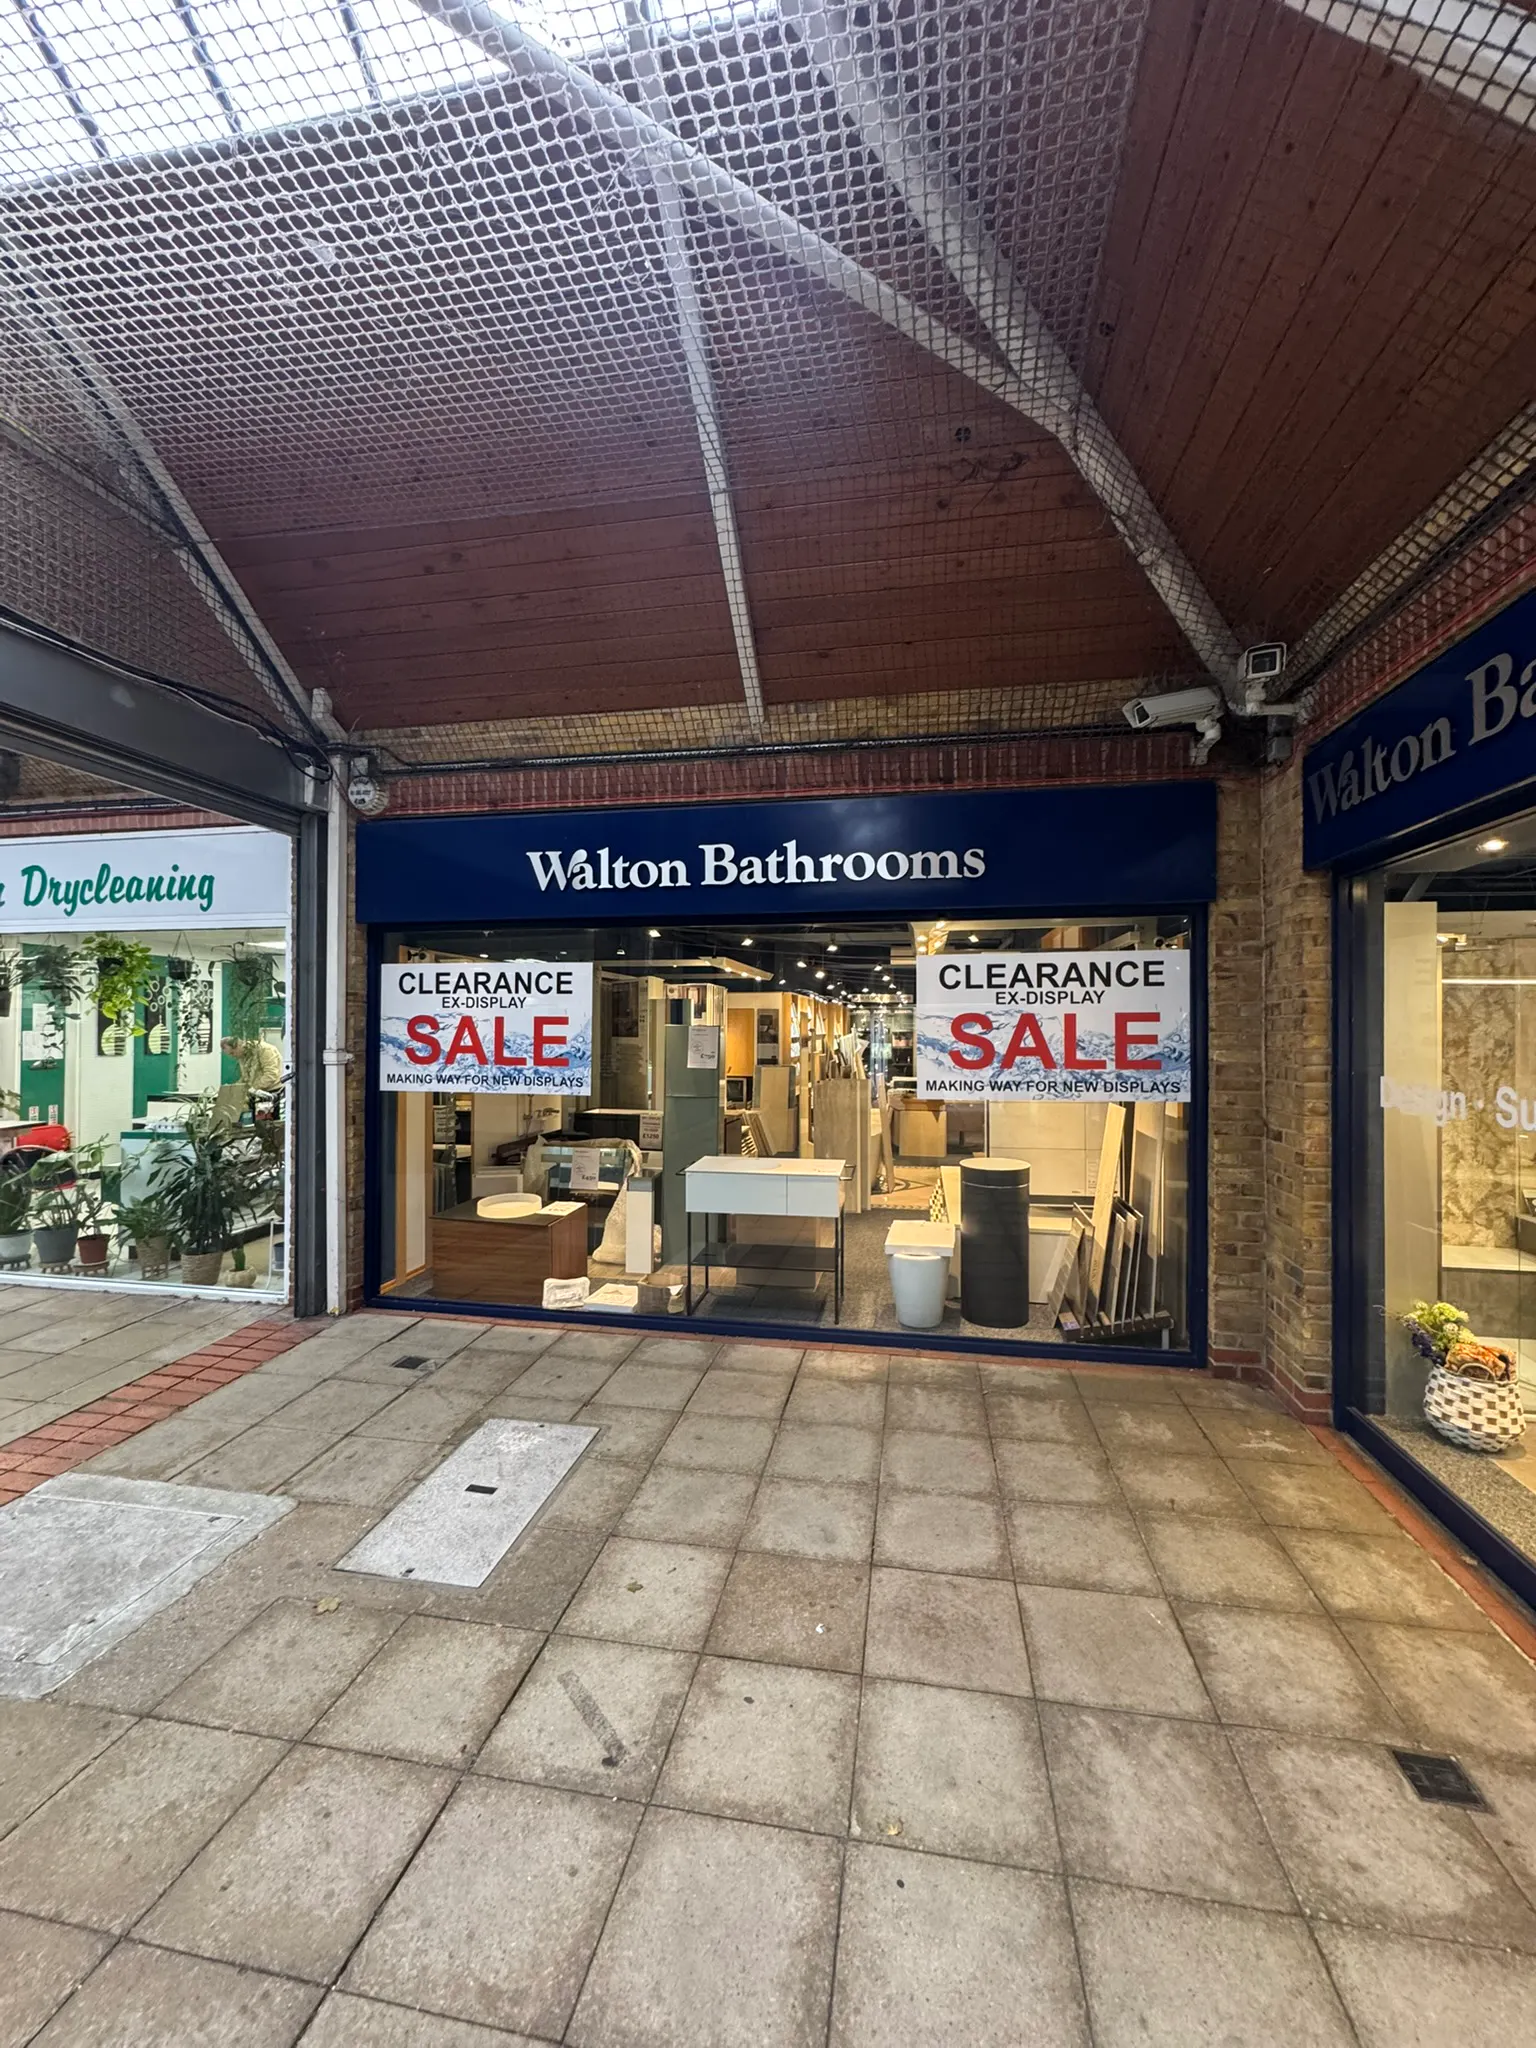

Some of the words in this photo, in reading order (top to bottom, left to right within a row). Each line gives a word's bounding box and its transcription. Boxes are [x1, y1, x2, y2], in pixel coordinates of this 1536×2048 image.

[1307, 717, 1456, 825] Walton
[526, 846, 691, 891] Walton
[698, 840, 986, 886] Bathrooms
[21, 863, 215, 917] Drycleaning
[398, 971, 573, 995] CLEARANCE
[938, 960, 1165, 990] CLEARANCE
[441, 996, 527, 1009] EX-DISPLAY
[995, 990, 1106, 1005] EX-DISPLAY
[404, 1015, 569, 1067] SALE
[948, 1012, 1162, 1070] SALE
[386, 1073, 433, 1085] MAKING
[435, 1074, 462, 1085] WAY
[464, 1074, 488, 1086] FOR
[492, 1075, 521, 1086] NEW
[523, 1075, 584, 1088] DISPLAYS
[925, 1080, 985, 1093] MAKING
[988, 1080, 1022, 1093] WAY
[1026, 1080, 1058, 1093] FOR
[1063, 1080, 1099, 1094] NEW
[1103, 1081, 1181, 1094] DISPLAYS
